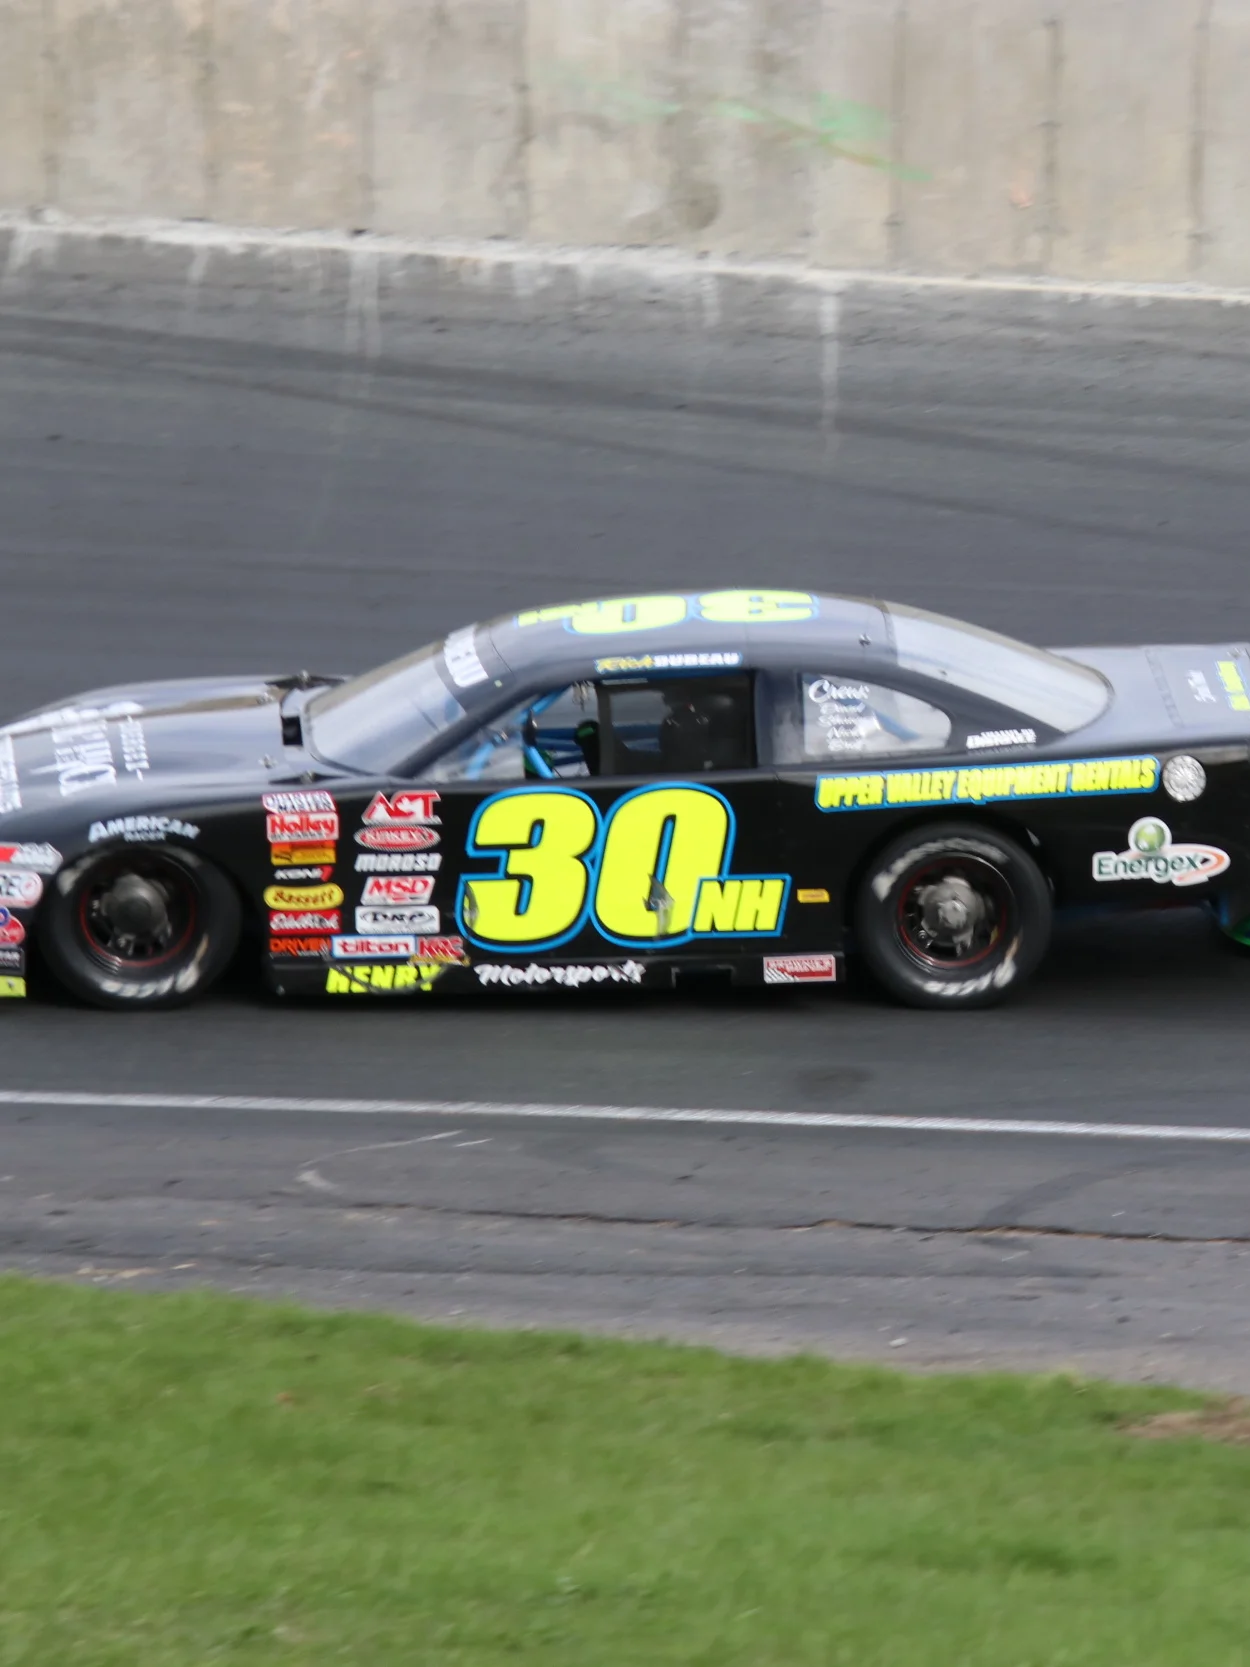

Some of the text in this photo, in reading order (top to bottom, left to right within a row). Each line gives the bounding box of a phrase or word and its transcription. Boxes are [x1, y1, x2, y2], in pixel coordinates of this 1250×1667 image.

[818, 776, 885, 808] UPPER
[886, 770, 957, 804] VALLEY
[957, 764, 1071, 801] EQUIPMENT
[1071, 757, 1156, 792] RENTALS
[366, 791, 441, 821] ACT
[88, 815, 200, 843] AMERICAN
[270, 814, 336, 838] Holley
[463, 786, 730, 942] 30
[1097, 852, 1200, 878] Energex
[369, 878, 430, 895] MSD
[692, 878, 786, 932] NH
[270, 938, 332, 957] DRIVEN
[337, 940, 412, 956] tilton
[325, 964, 442, 995] HENRY
